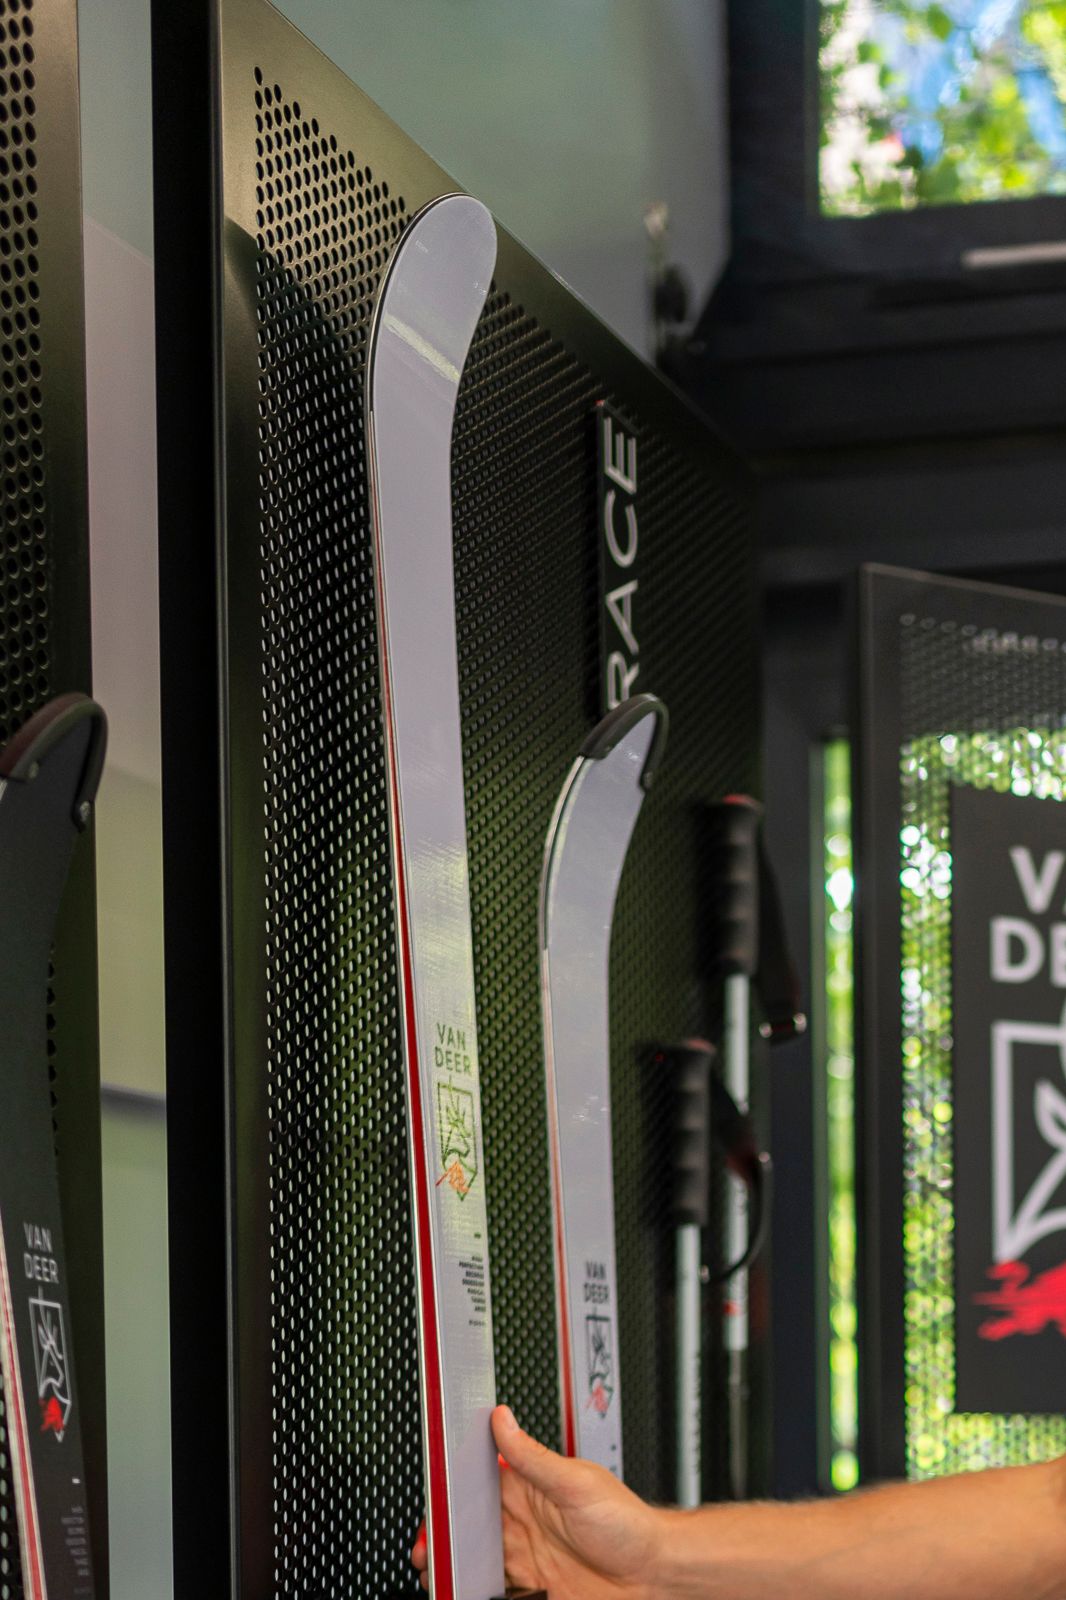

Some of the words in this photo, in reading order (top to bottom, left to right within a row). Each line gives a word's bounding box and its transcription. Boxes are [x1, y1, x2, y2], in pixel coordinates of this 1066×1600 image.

[603, 416, 640, 710] RACE
[436, 1022, 466, 1051] VAN
[434, 1046, 472, 1076] DEER
[23, 1222, 53, 1253] VAN
[23, 1252, 59, 1284] DEER
[585, 1261, 607, 1280] VAN
[583, 1282, 610, 1304] DEER
